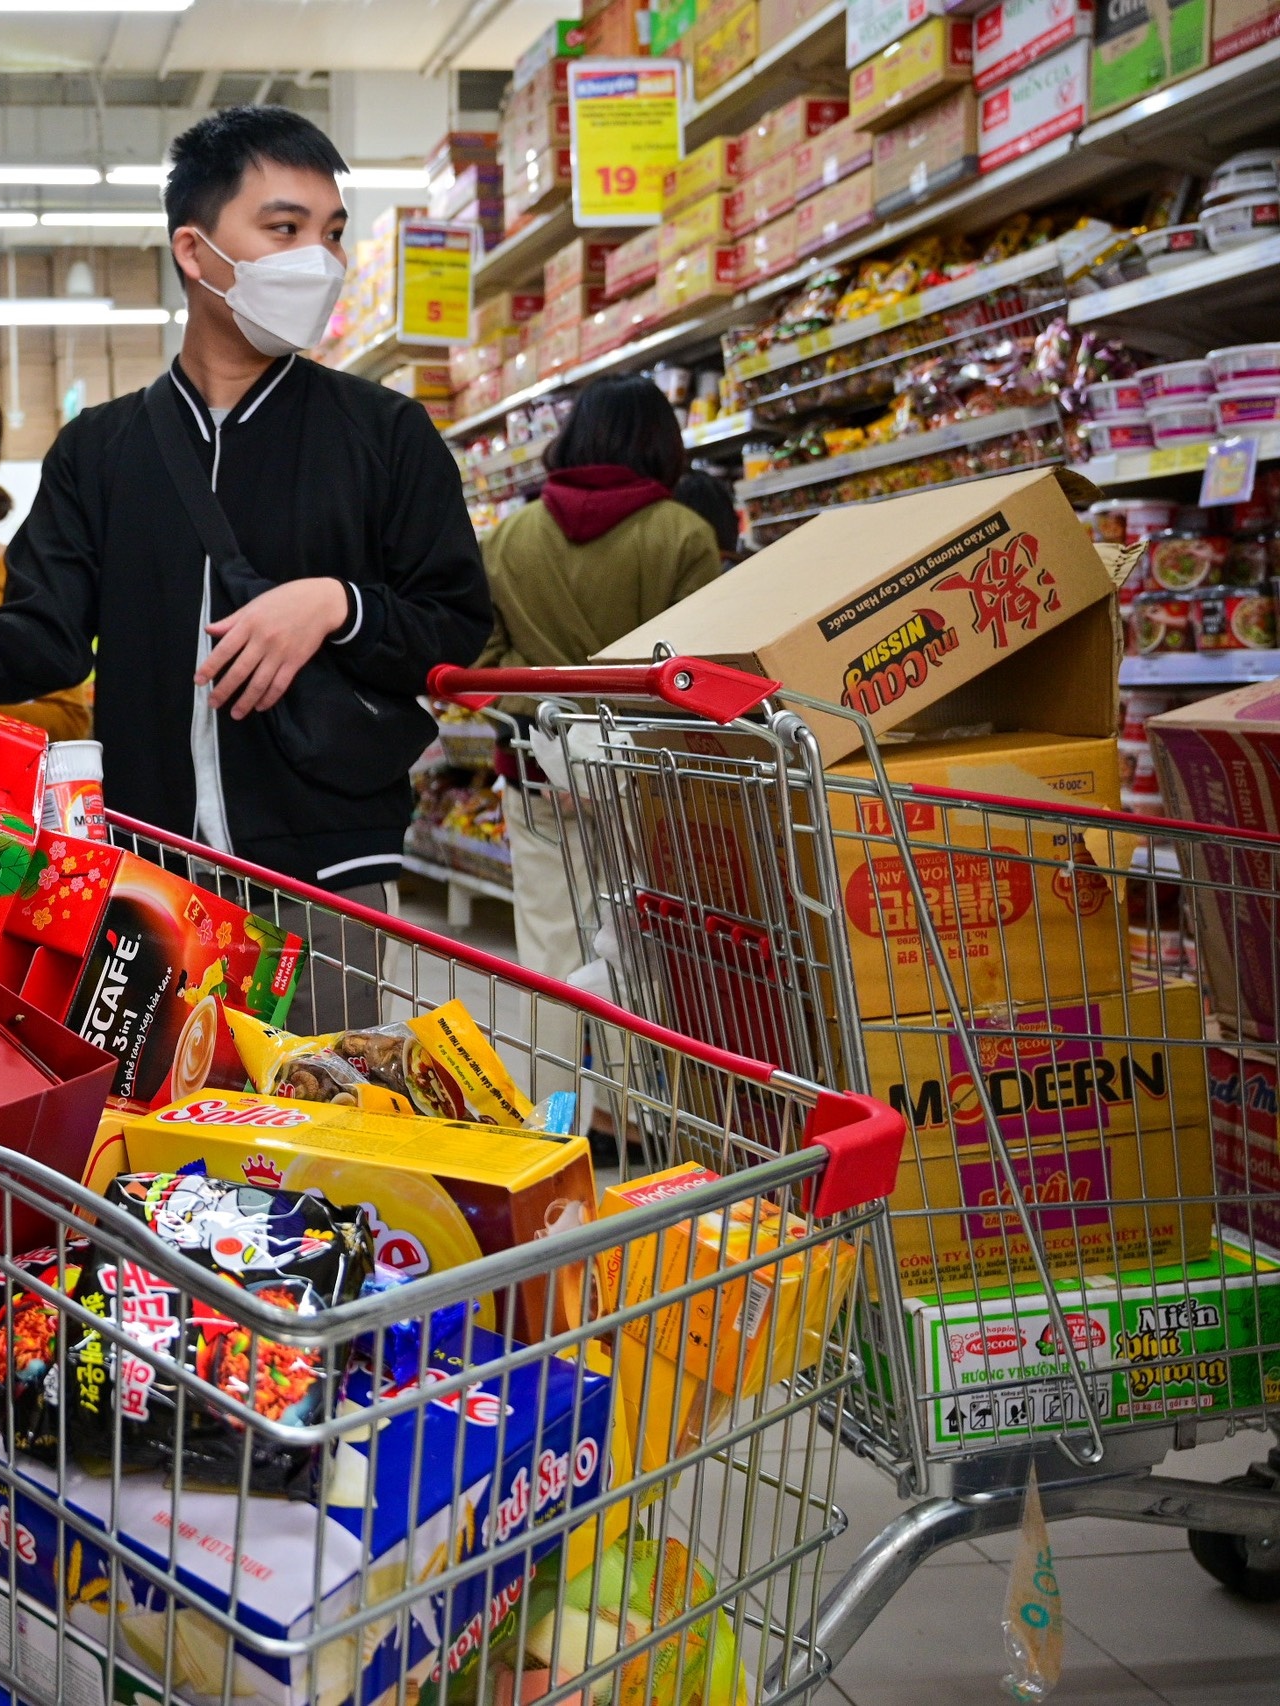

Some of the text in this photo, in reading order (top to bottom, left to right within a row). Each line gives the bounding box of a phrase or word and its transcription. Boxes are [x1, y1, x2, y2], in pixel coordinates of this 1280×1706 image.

[596, 166, 637, 195] 19
[826, 520, 1001, 631] Mì Xào Hương Vị Gà Cay Hàn Quốc
[861, 615, 926, 672] NISSIN
[841, 650, 929, 717] cay
[911, 808, 924, 824] 7
[189, 903, 201, 921] LỘC
[285, 956, 295, 974] HÒA
[82, 928, 140, 1050] SCAFÉ
[146, 993, 161, 1013] hòa
[139, 1011, 155, 1033] xay
[130, 1034, 146, 1059] rang
[448, 1034, 461, 1048] THU
[124, 1060, 136, 1081] phê
[469, 1059, 484, 1077] THỰC
[121, 1081, 132, 1097] Cà
[479, 1075, 493, 1090] SẢN
[888, 1052, 1166, 1127] MODERN
[157, 1100, 312, 1128] Solite
[942, 1251, 962, 1262] TY
